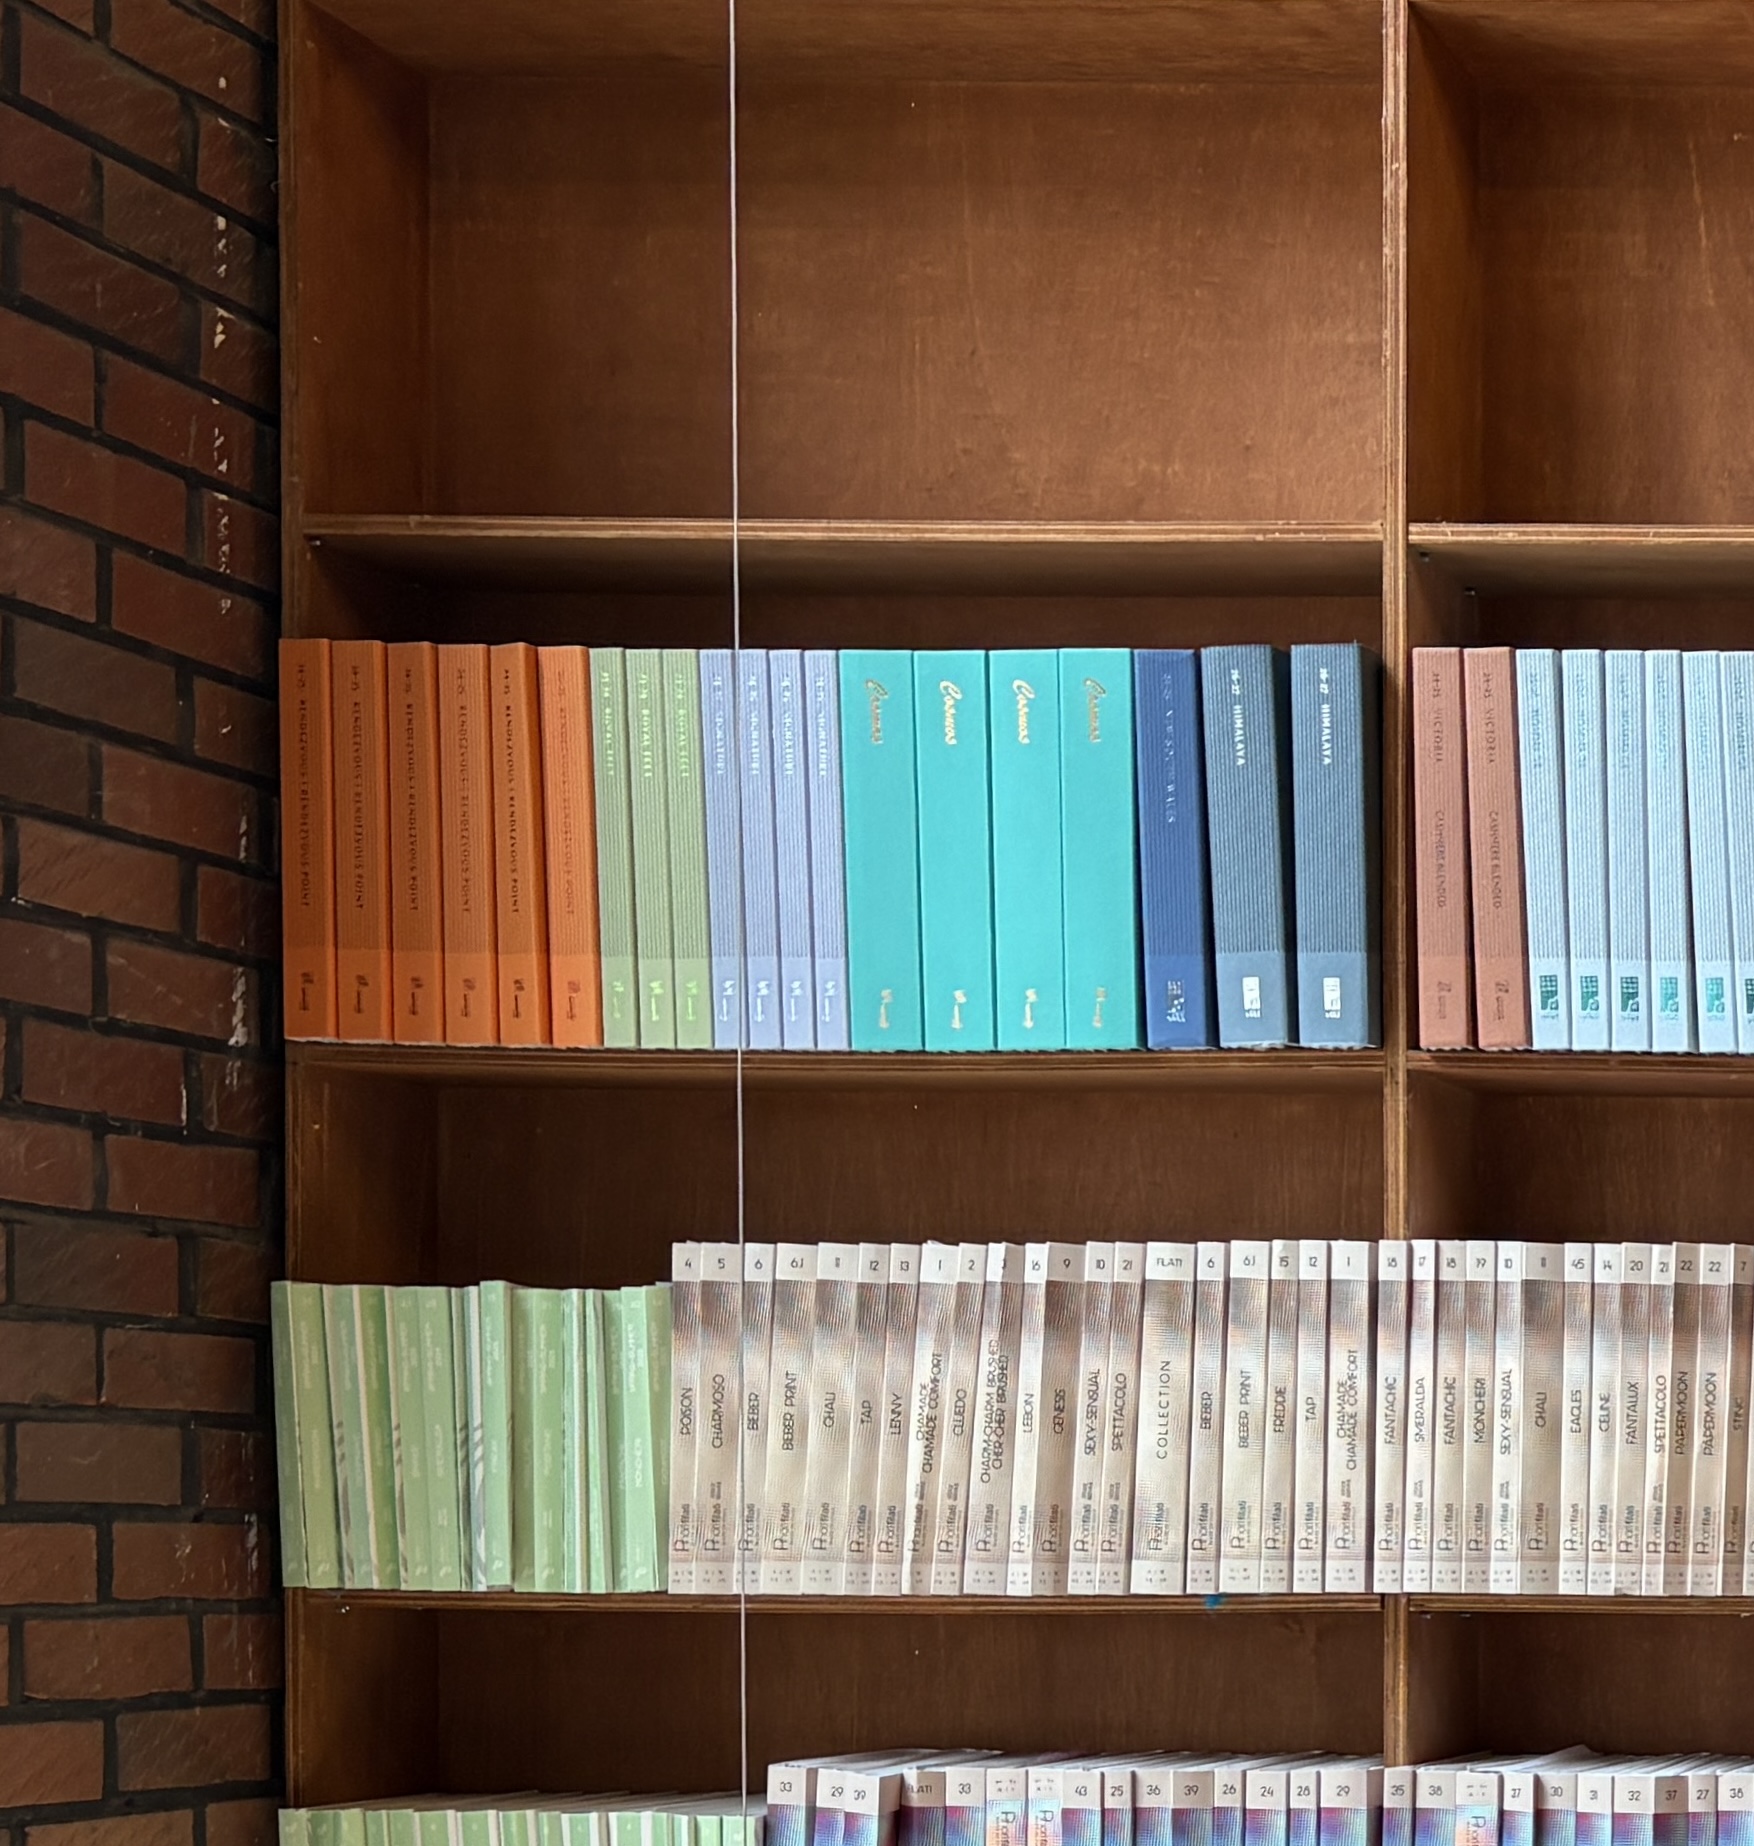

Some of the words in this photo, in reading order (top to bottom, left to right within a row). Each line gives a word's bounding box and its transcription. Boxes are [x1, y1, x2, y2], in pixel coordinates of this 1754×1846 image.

[1232, 704, 1247, 766] HIMALAYA
[1319, 703, 1333, 765] HIMALAYA
[684, 1259, 692, 1269] 4
[717, 1258, 726, 1269] 5
[754, 1259, 763, 1270] 6
[869, 1260, 880, 1271] 12
[899, 1261, 910, 1272] 13
[1063, 1258, 1071, 1269] 9
[1122, 1259, 1133, 1271] 21
[1629, 1260, 1644, 1271] 20
[1680, 1259, 1693, 1271] 22
[1346, 1348, 1358, 1407] COMFORT
[783, 1370, 797, 1407] PRINT
[680, 1388, 694, 1436] POISON
[711, 1374, 724, 1449] CHARMOSO
[747, 1392, 760, 1431] BEBER
[860, 1399, 873, 1424] TAP
[890, 1392, 903, 1436] LENNY
[1022, 1392, 1035, 1434] LEBON
[1053, 1388, 1066, 1435] GENESIS
[1083, 1368, 1101, 1456] SEXY-SENSUAL
[1112, 1372, 1127, 1452] SPETTACOLO
[1156, 1360, 1171, 1460] COLLECTION
[1674, 1371, 1689, 1456] PAPERMOON
[782, 1412, 795, 1451] BEBER
[1345, 1410, 1358, 1471] CHAMADE
[779, 1782, 793, 1792] 33
[1074, 1785, 1088, 1796] 43
[1110, 1785, 1124, 1797] 25
[1183, 1785, 1199, 1796] 39
[1259, 1786, 1275, 1797] 24
[1336, 1785, 1351, 1797] 29
[1549, 1785, 1563, 1797] 30
[1627, 1790, 1642, 1801] 32
[1696, 1789, 1710, 1800] 27
